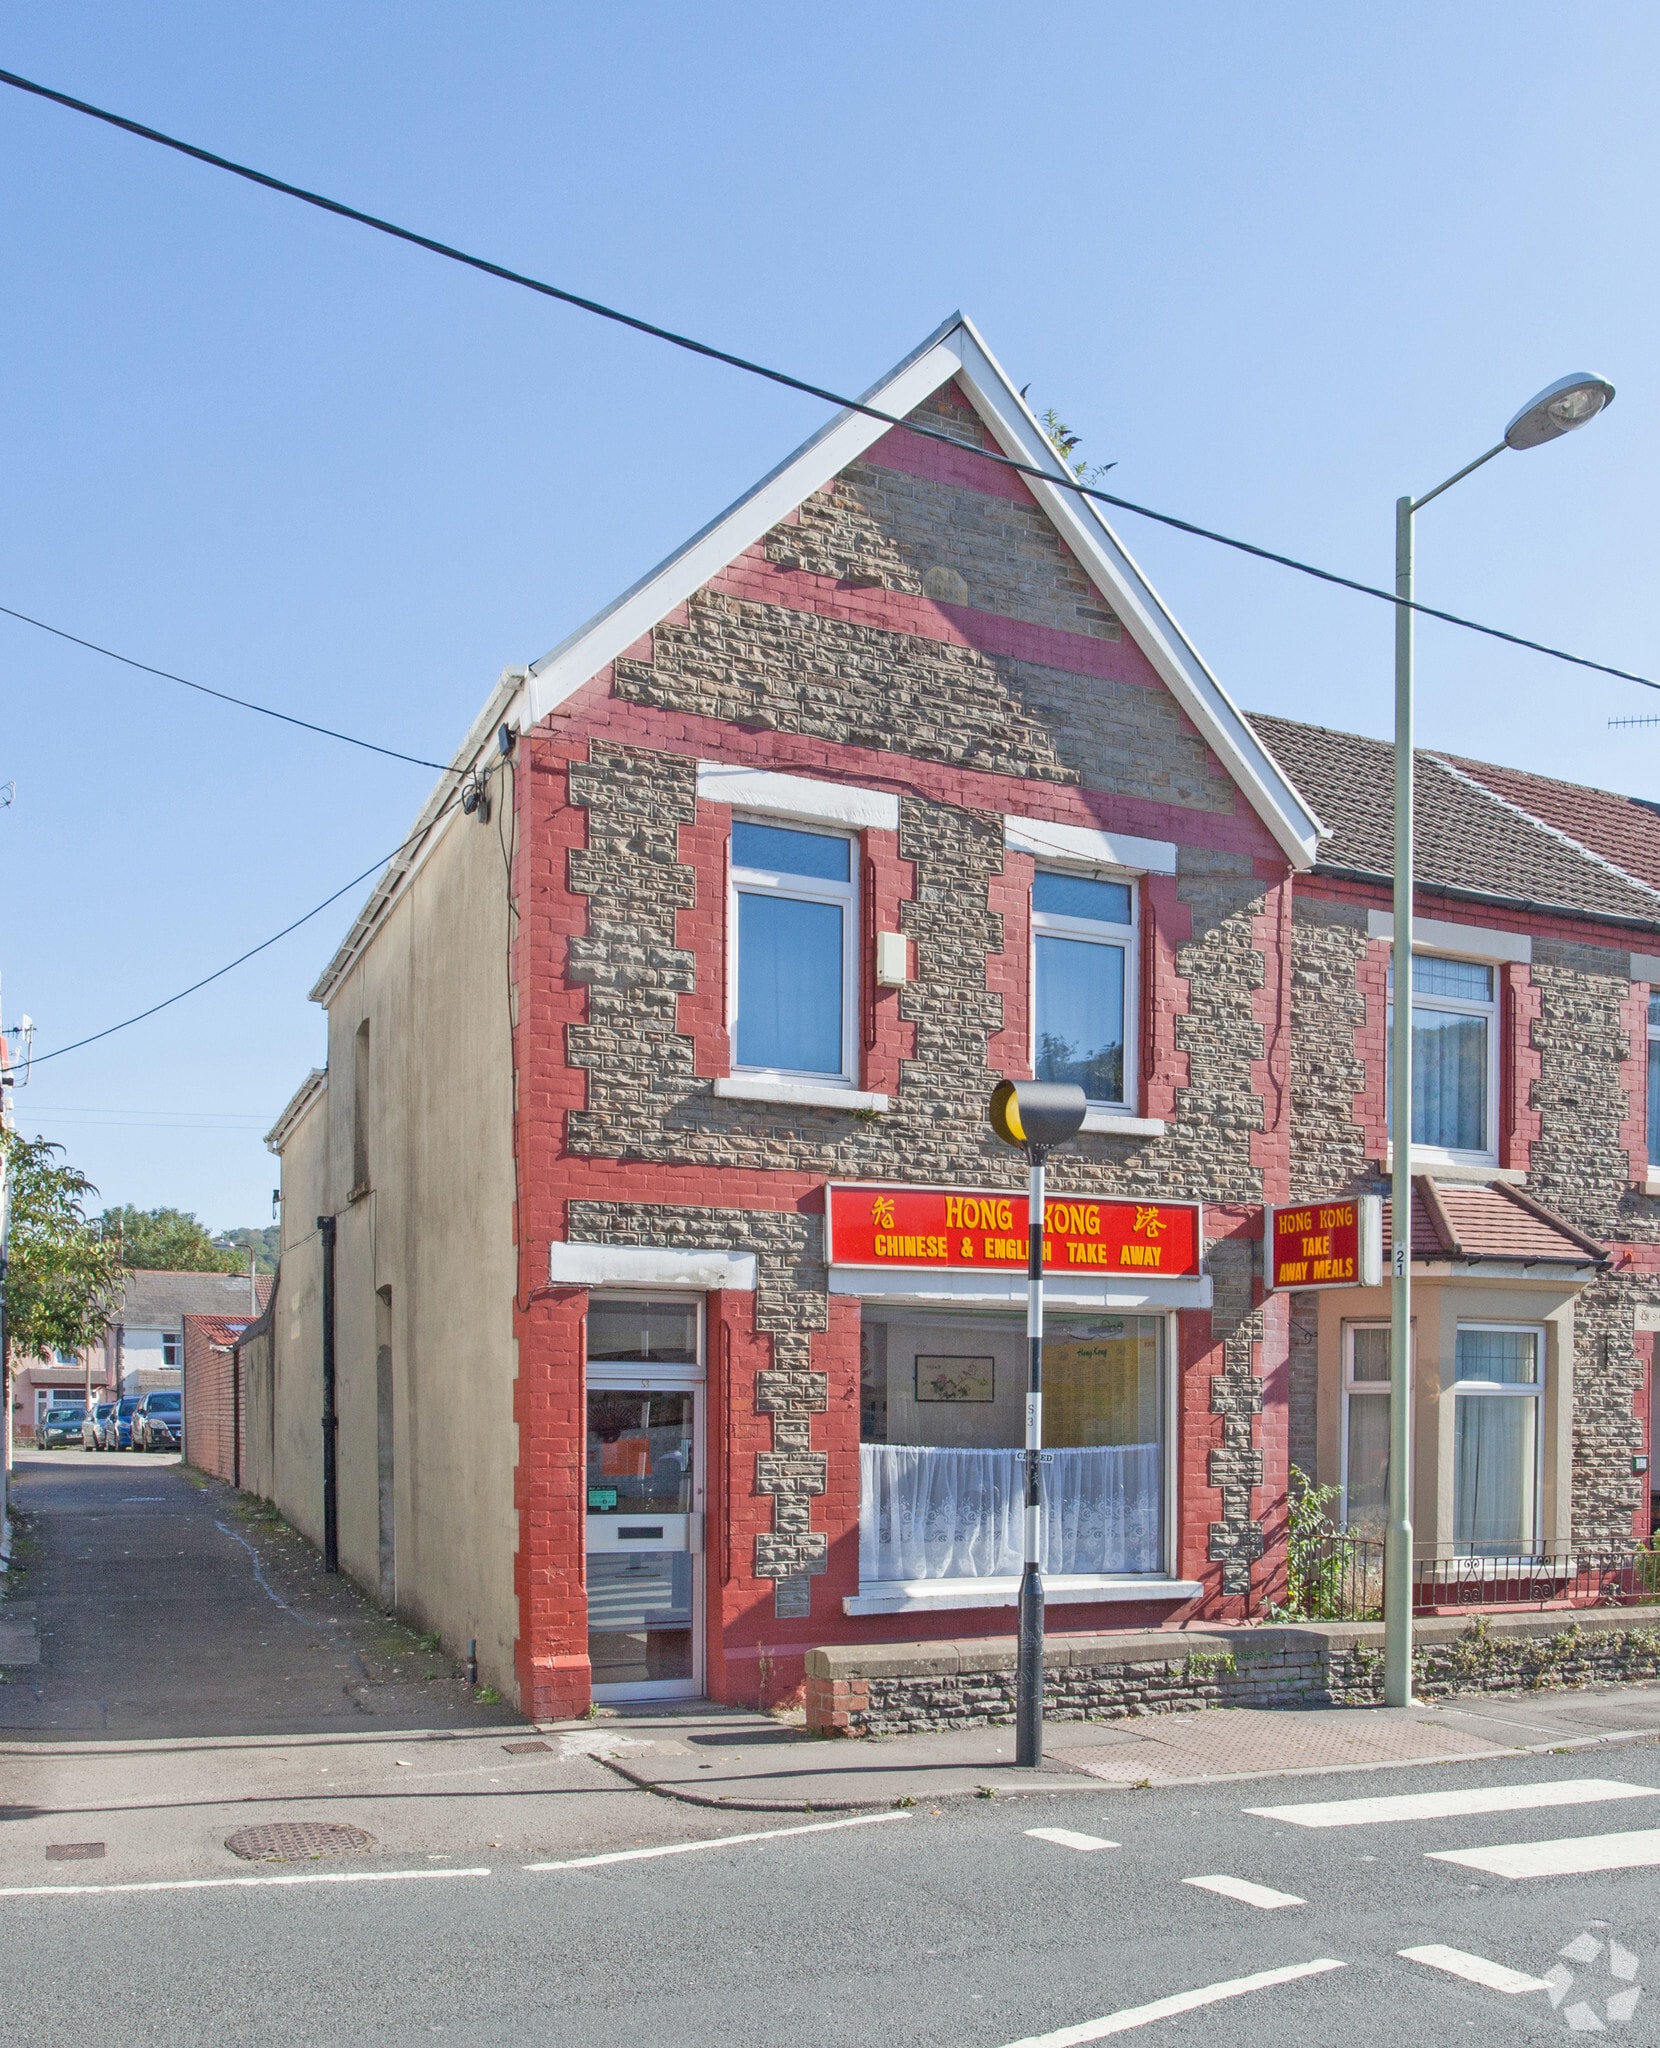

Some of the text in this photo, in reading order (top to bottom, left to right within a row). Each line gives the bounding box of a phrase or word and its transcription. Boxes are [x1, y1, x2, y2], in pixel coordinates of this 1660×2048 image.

[872, 1196, 895, 1229] 香
[945, 1196, 1012, 1231] HONG
[1133, 1205, 1167, 1238] 港
[1279, 1206, 1353, 1234] HONG KONG
[874, 1234, 1162, 1267] CHINESE & ENGLIH TAKE AWAY
[1302, 1235, 1330, 1257] TAKE
[1279, 1257, 1353, 1282] AWAY MEALS
[1016, 1452, 1053, 1462] CLED
